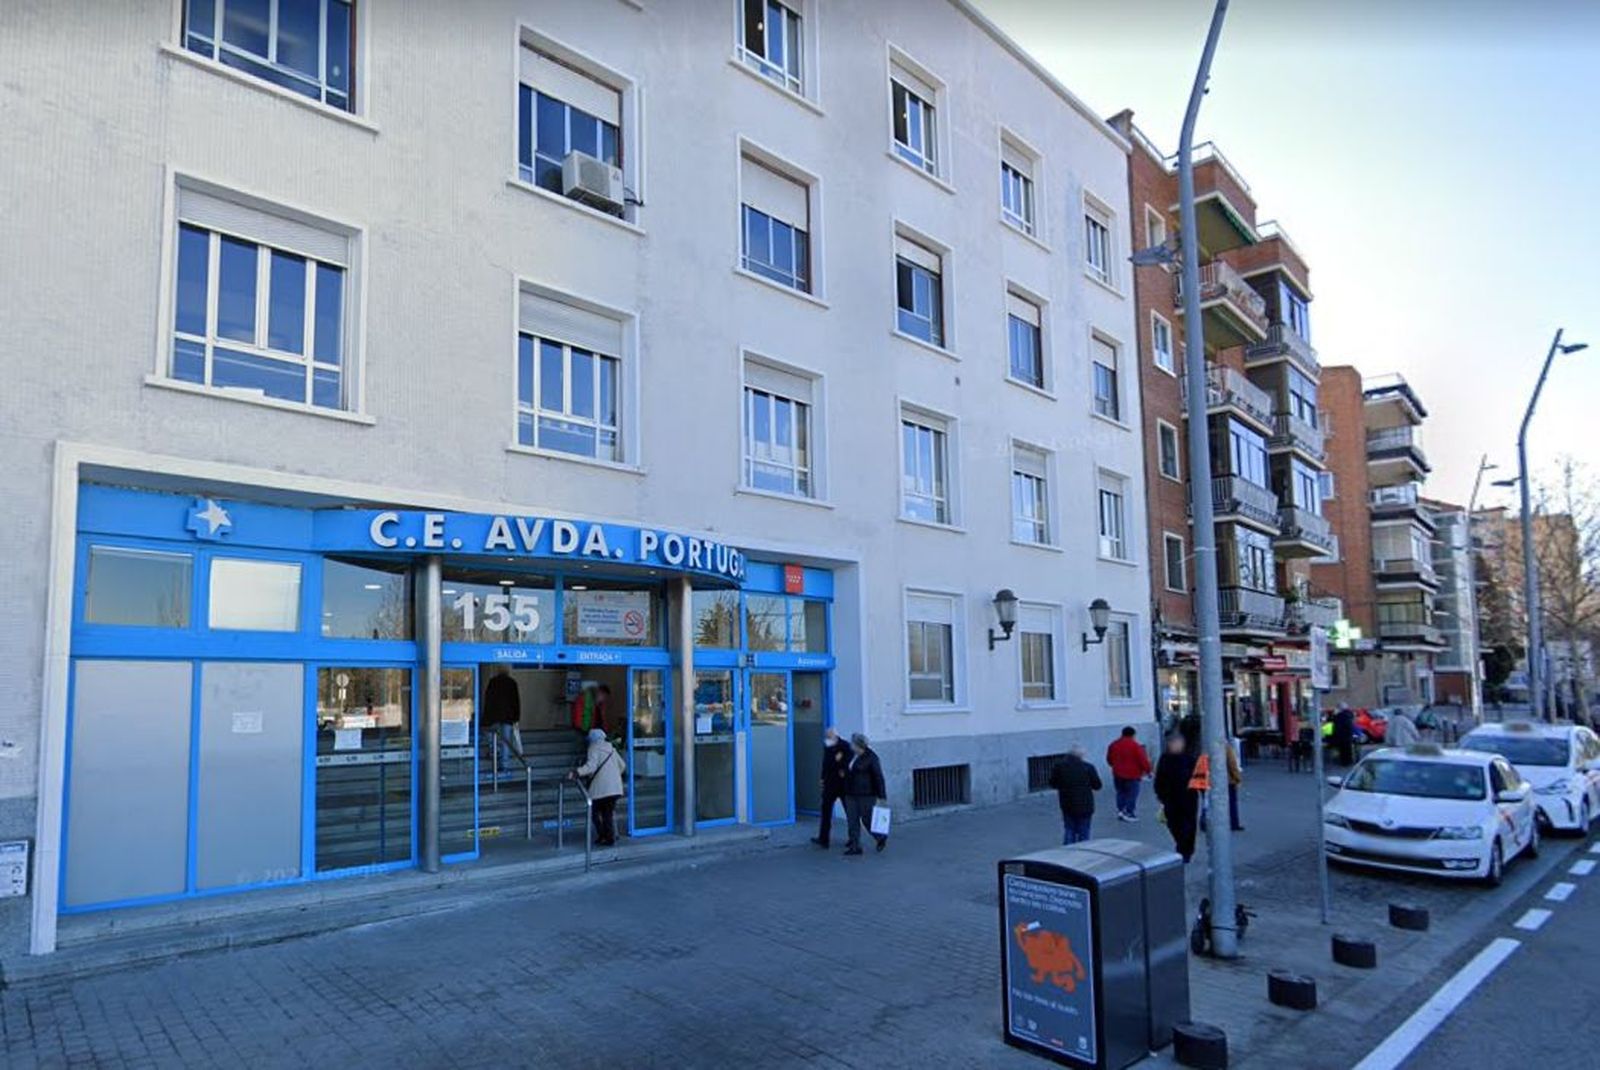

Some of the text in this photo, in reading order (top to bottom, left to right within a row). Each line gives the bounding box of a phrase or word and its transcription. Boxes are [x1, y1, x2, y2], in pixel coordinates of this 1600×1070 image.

[370, 511, 462, 548] C.E.
[485, 516, 624, 558] AVDA.
[453, 592, 540, 631] 155
[496, 648, 528, 659] SALIDA
